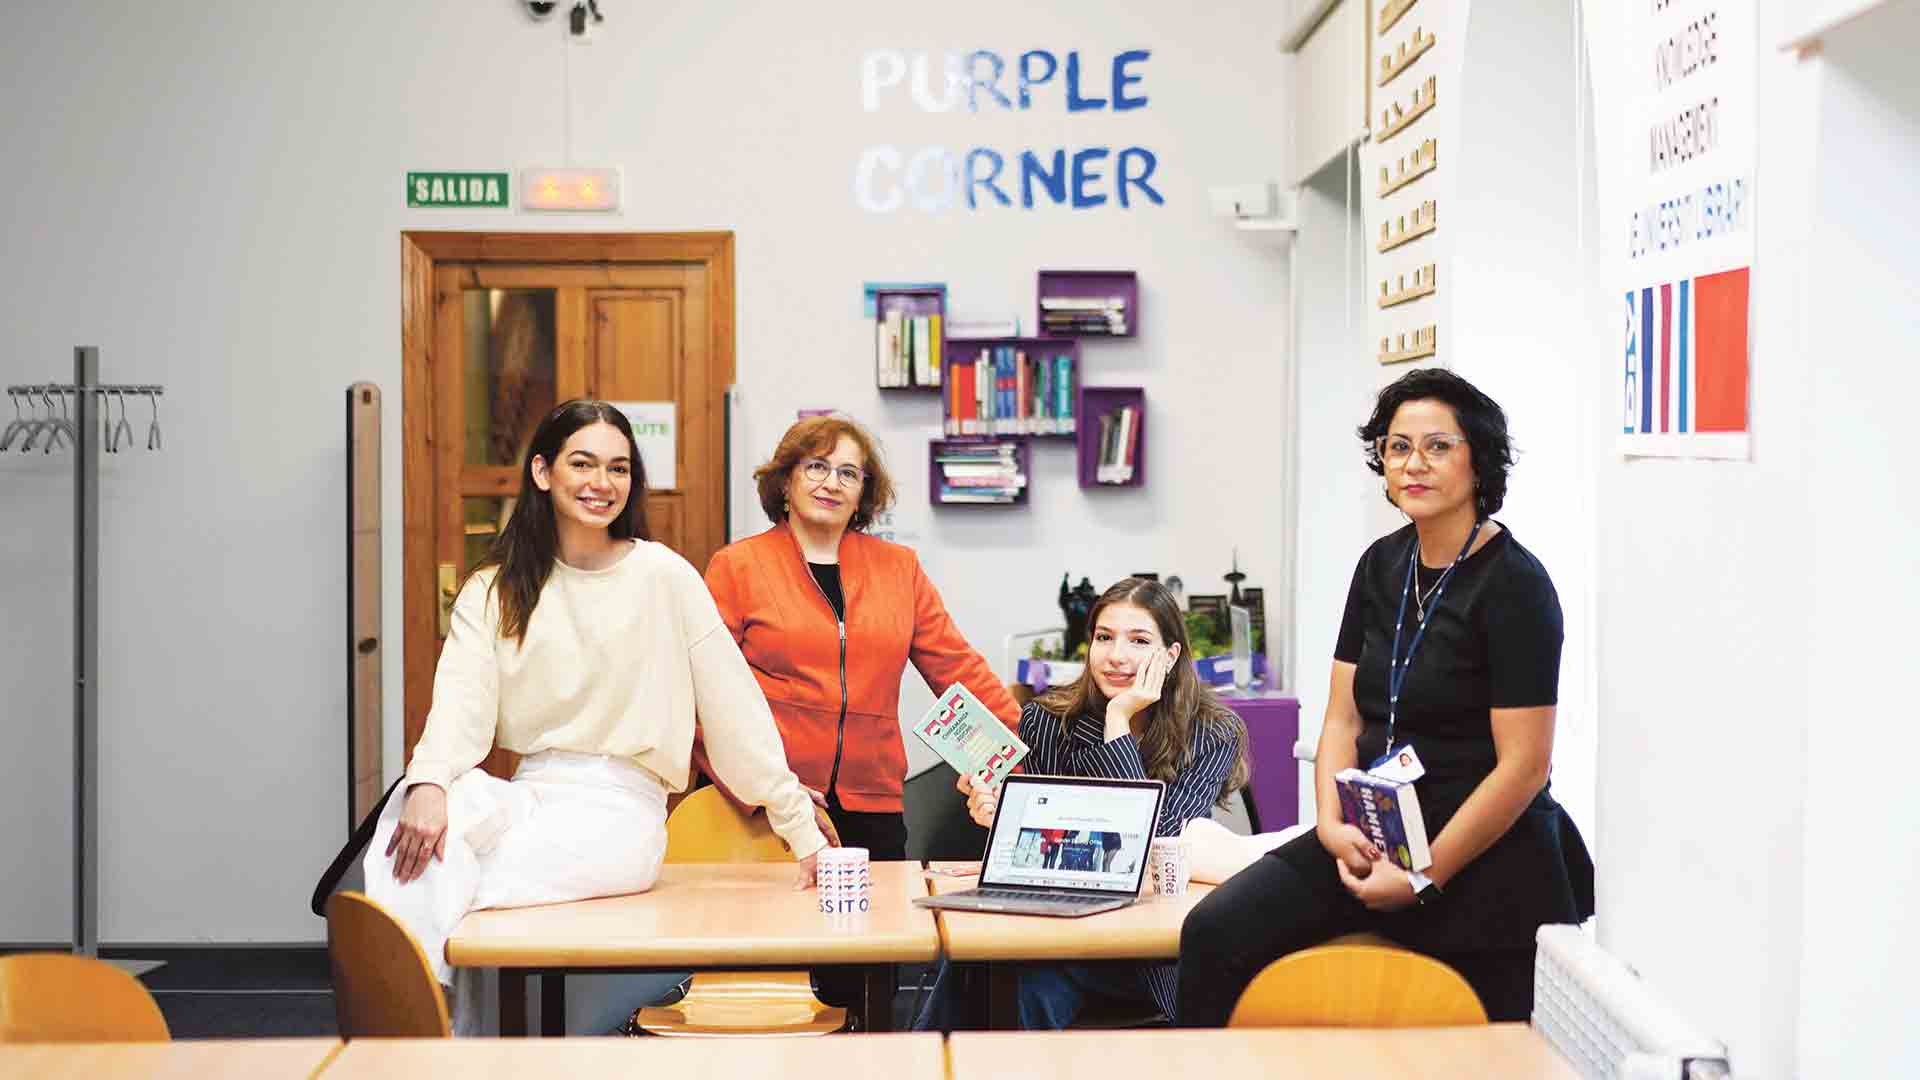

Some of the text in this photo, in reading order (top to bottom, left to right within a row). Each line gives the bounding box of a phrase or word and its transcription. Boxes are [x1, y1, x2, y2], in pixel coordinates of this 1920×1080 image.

[863, 48, 1153, 113] PURPLE
[415, 177, 500, 202] SALIDA
[856, 145, 1165, 213] CORNER
